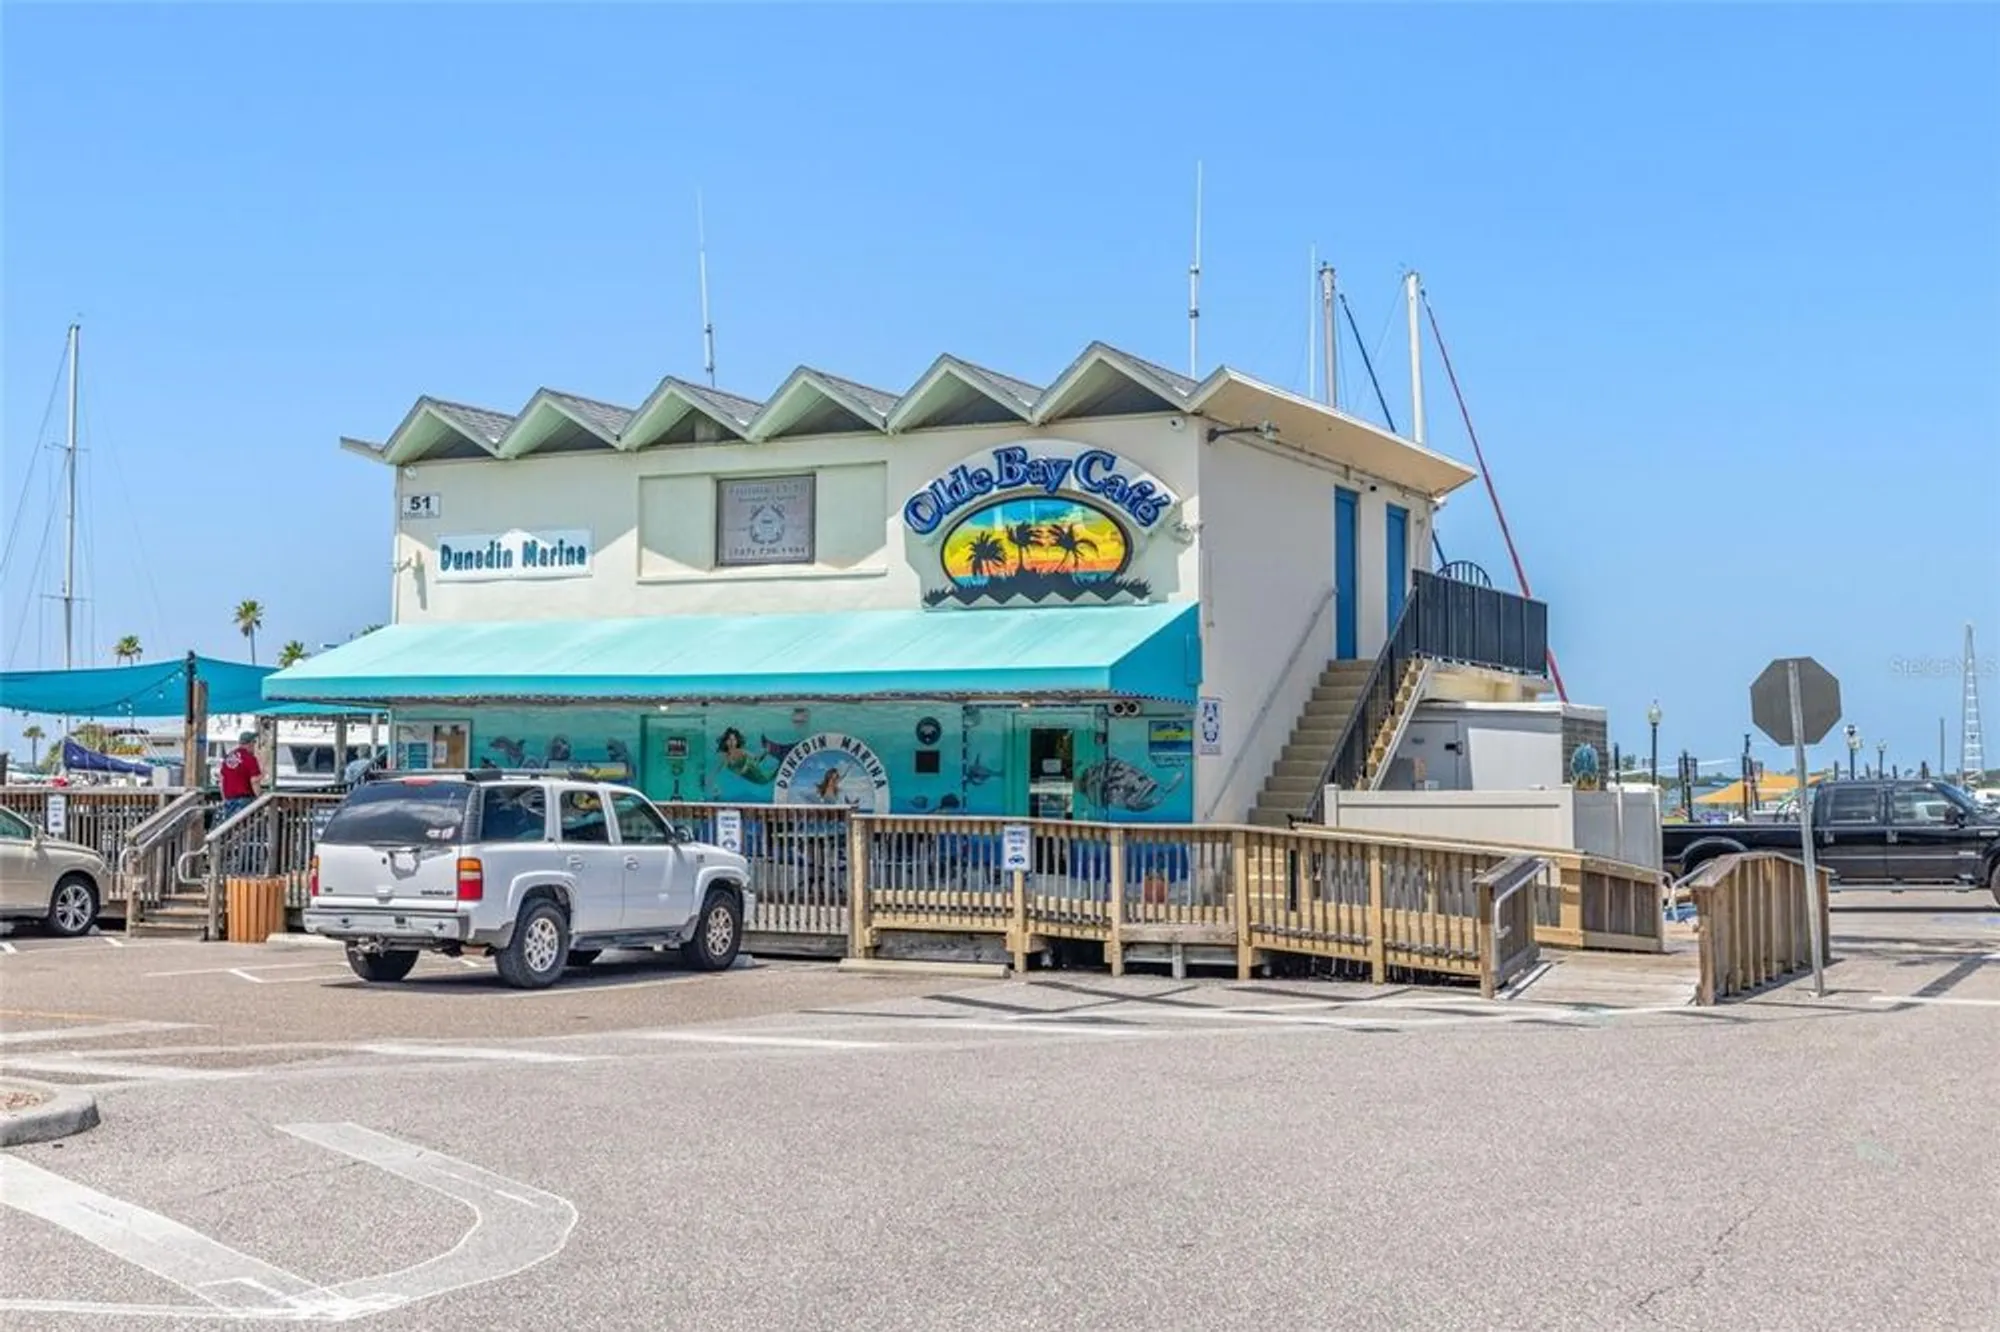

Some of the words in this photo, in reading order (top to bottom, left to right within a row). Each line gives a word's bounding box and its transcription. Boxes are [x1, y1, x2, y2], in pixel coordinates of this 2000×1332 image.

[410, 495, 431, 511] 51
[904, 464, 993, 535] Olde
[993, 446, 1073, 493] Bay
[1074, 449, 1171, 527] Café
[440, 538, 513, 572] Dunedin
[521, 538, 587, 569] Marina
[776, 735, 828, 790] DUNEDIN
[840, 735, 887, 790] MARINA
